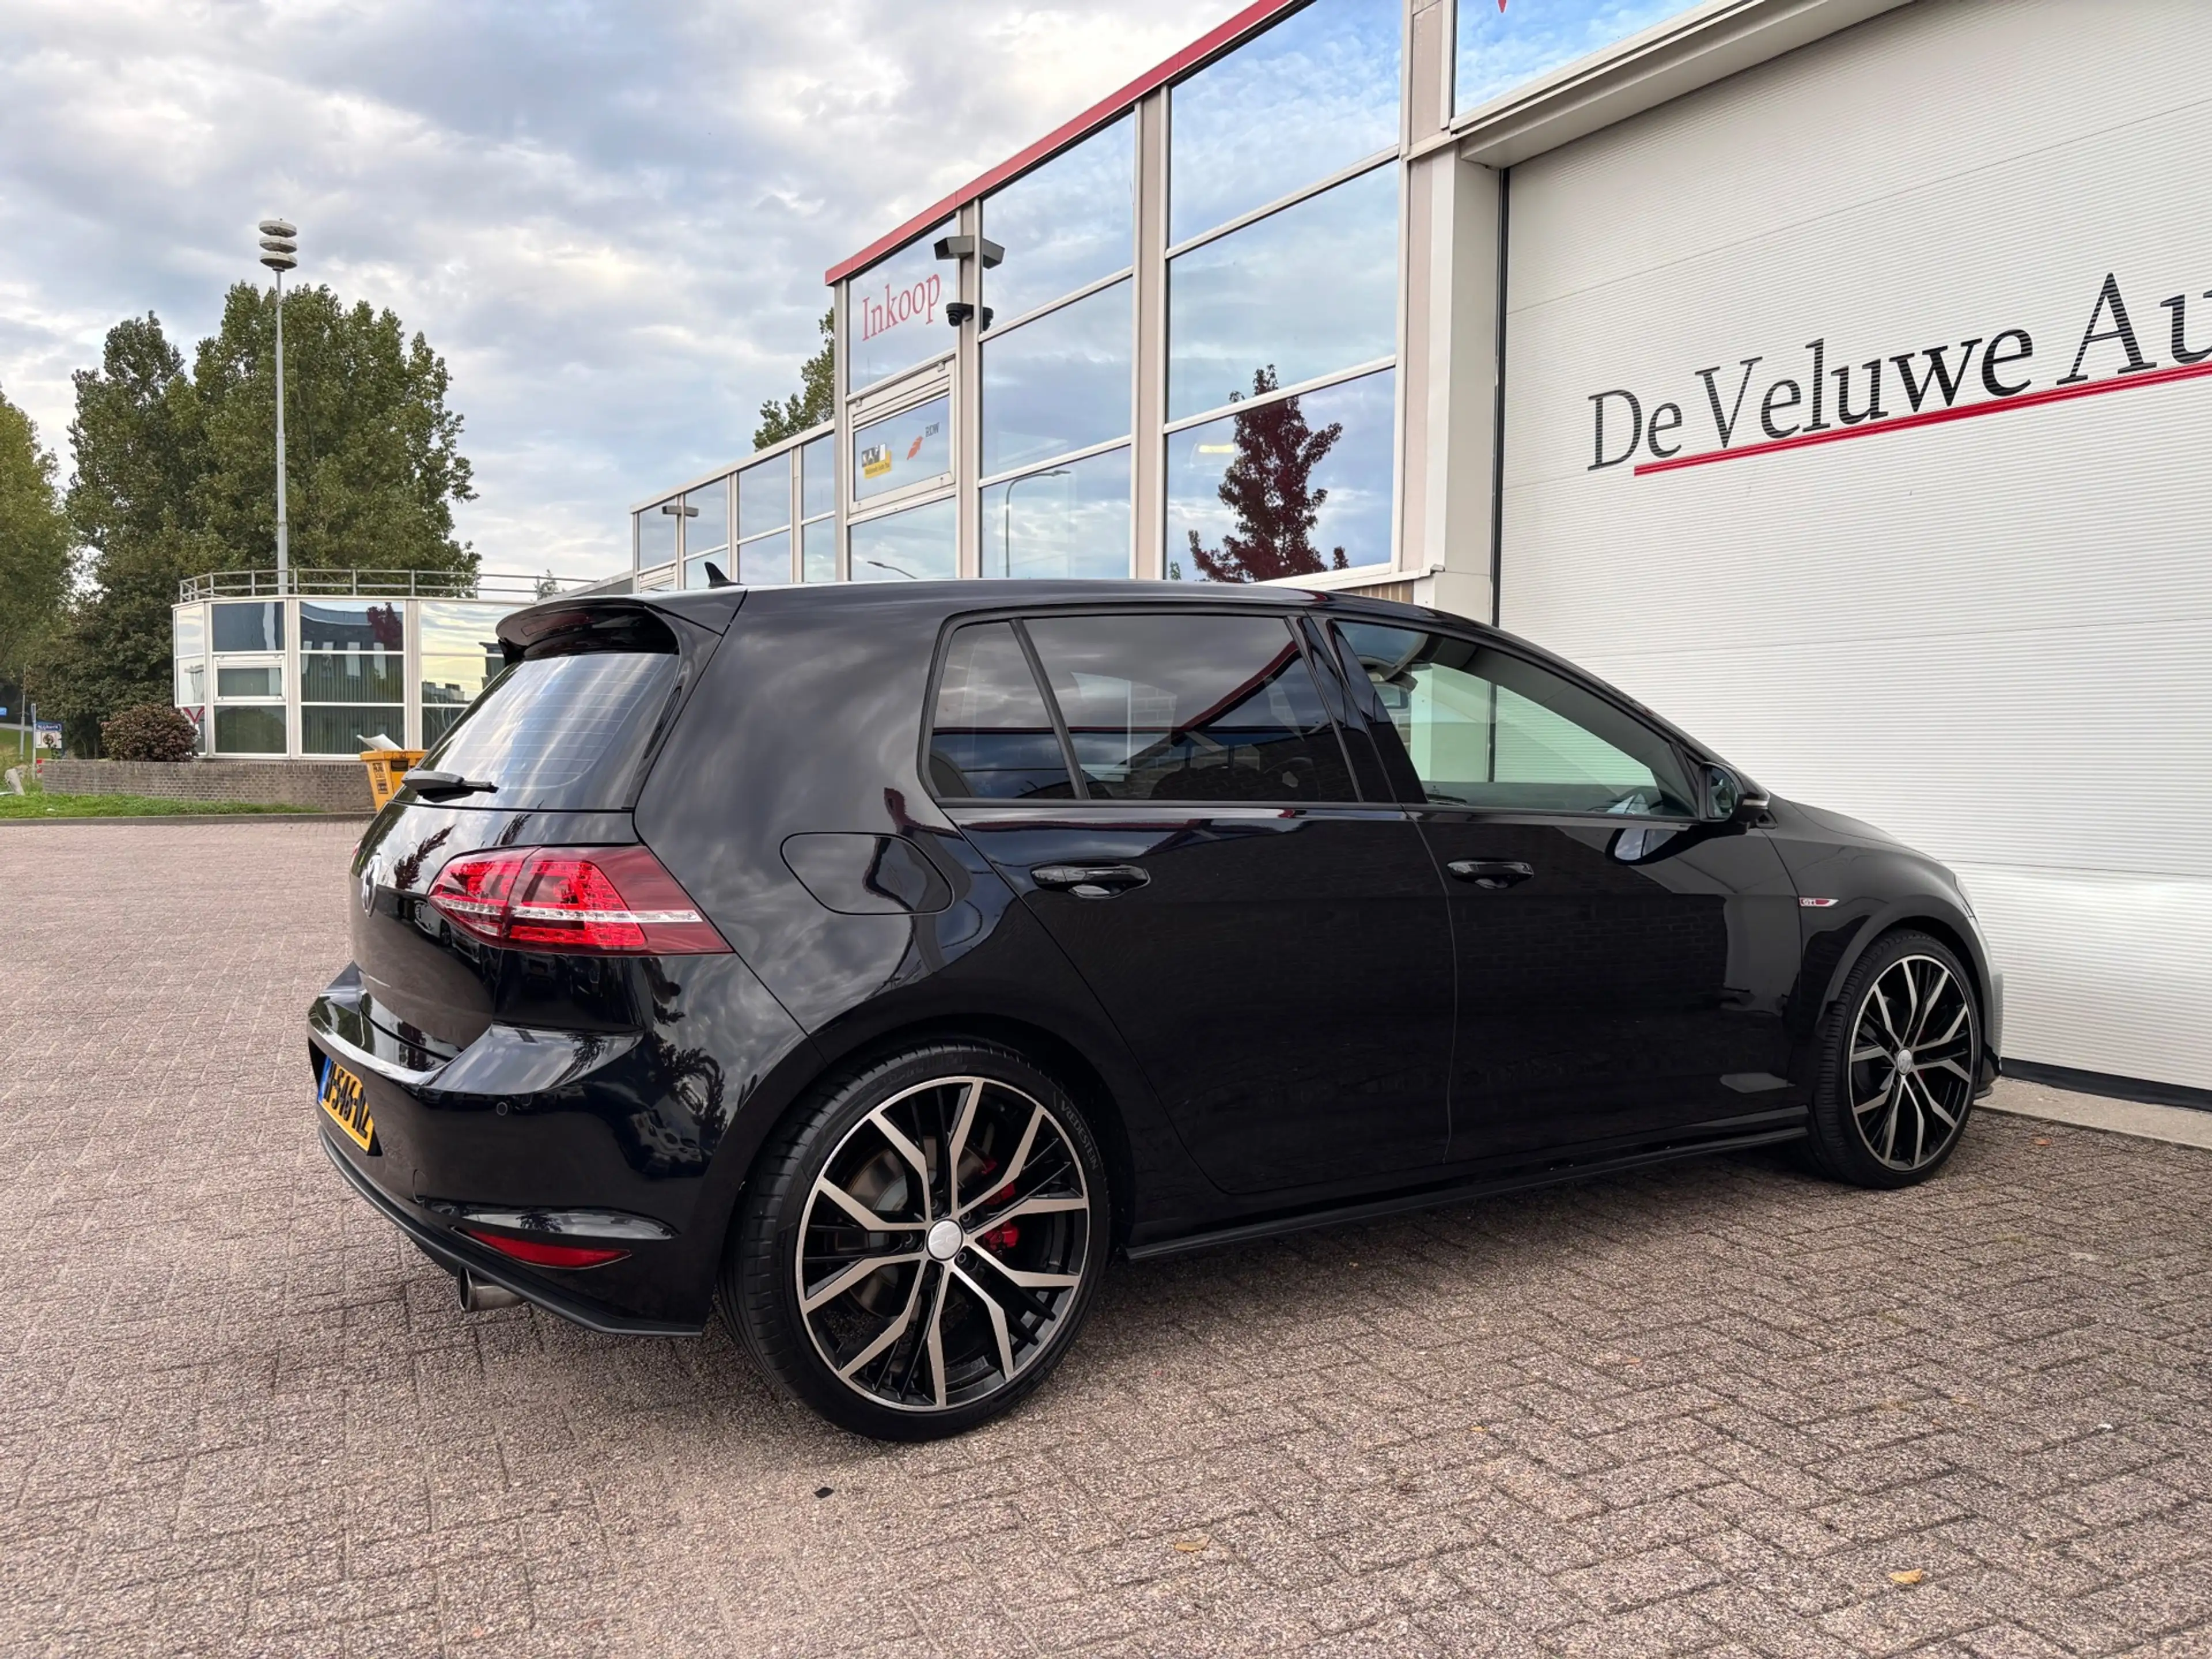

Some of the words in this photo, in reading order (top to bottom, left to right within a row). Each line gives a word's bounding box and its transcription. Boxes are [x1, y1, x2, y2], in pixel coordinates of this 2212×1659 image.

[862, 274, 941, 341] Inkoop
[925, 422, 940, 437] RDW
[1587, 388, 1683, 471] De
[1695, 328, 2034, 448] Veluwe
[1061, 1100, 1099, 1170] VREDESTEIN
